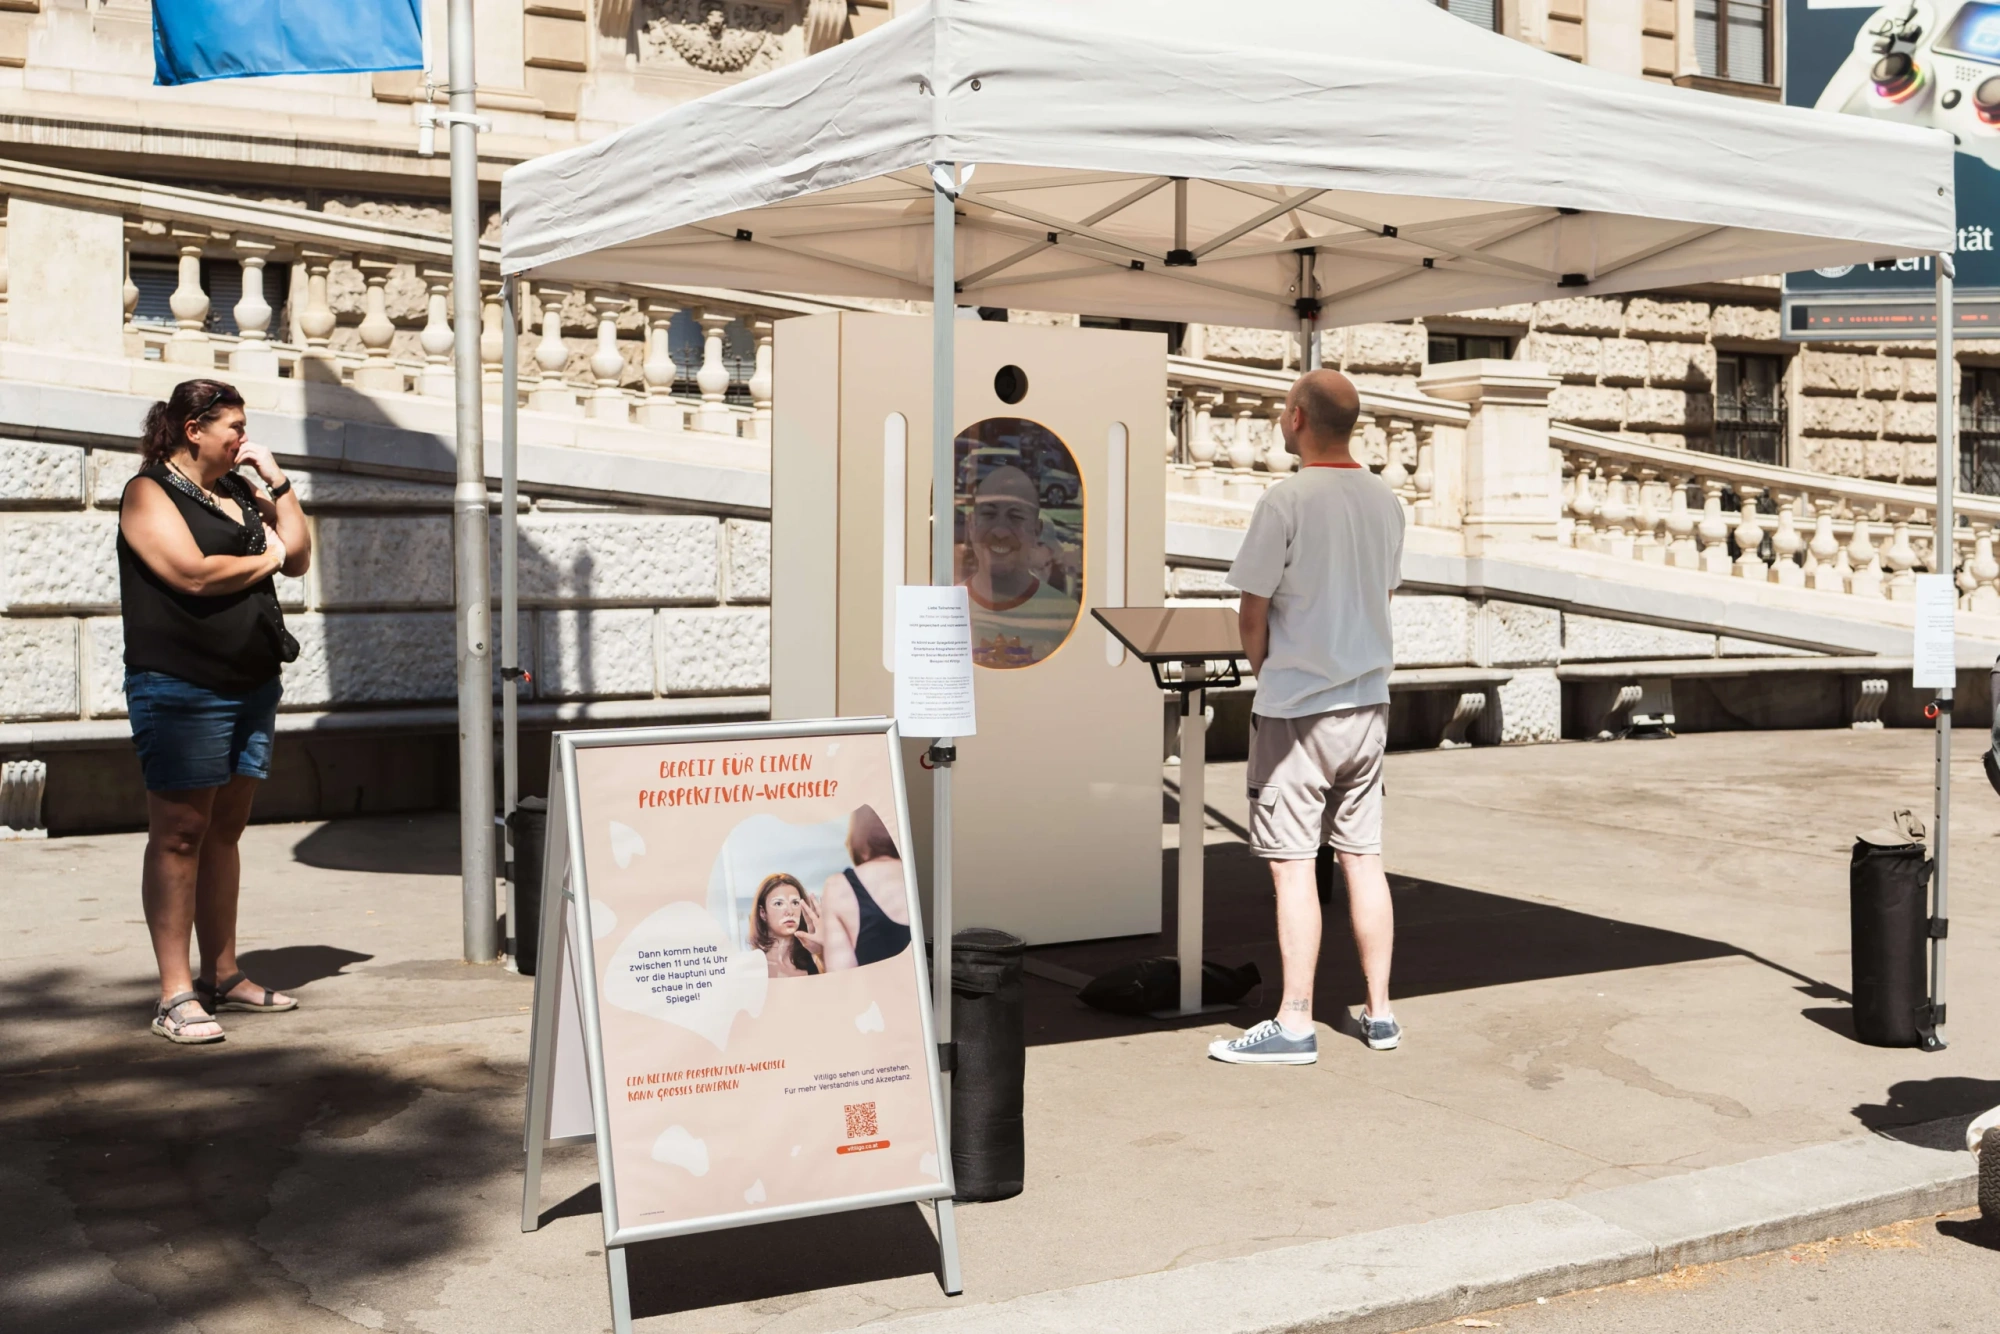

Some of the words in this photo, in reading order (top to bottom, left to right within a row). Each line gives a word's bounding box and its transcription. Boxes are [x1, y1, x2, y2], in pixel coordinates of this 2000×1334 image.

[660, 759, 715, 778] BEREIT
[722, 753, 753, 776] FÜR
[760, 753, 812, 773] EINEN
[639, 779, 838, 808] PERSPEKTIVEN-WECHSEL?
[638, 951, 661, 959] Dann
[663, 948, 691, 956] komm
[693, 945, 717, 954] heute
[630, 962, 671, 971] zwischen
[684, 958, 700, 966] und
[652, 973, 665, 981] die
[668, 970, 706, 980] Hauptuni
[709, 967, 725, 975] und
[652, 984, 683, 993] schaue
[666, 993, 700, 1004] Spiegel!
[627, 1076, 644, 1086] EIN
[647, 1071, 683, 1084] KLEINER
[686, 1060, 785, 1079] PERSPEKTIVEN-WECHSEL
[814, 1073, 837, 1081] Vitiligo
[628, 1090, 653, 1102] KANN
[657, 1085, 692, 1101] GROSSES
[696, 1079, 739, 1093] BEWIRKEN
[798, 1085, 817, 1093] mehr
